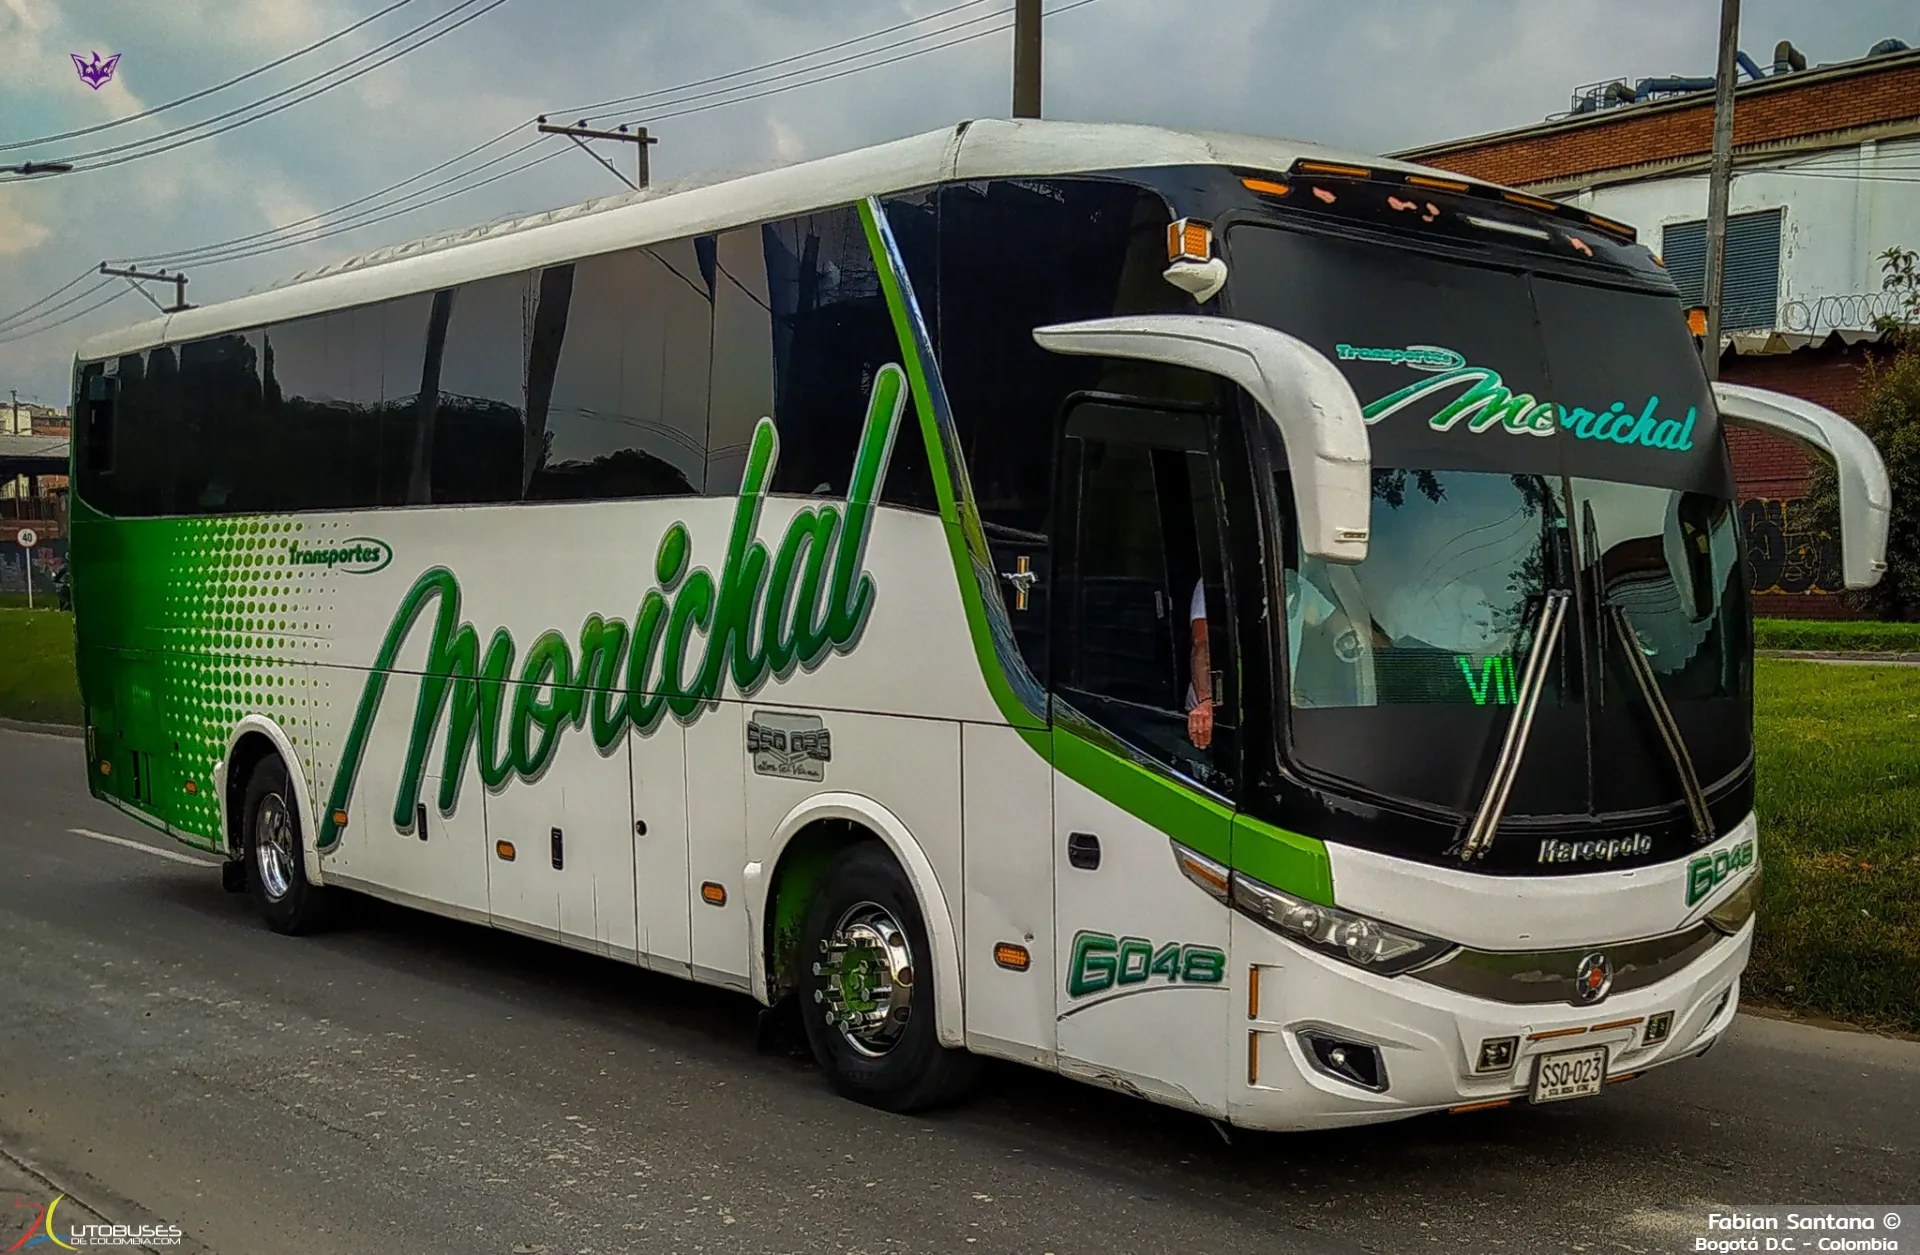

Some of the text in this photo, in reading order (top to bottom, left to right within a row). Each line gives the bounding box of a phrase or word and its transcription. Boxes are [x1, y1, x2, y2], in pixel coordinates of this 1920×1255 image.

[1335, 344, 1453, 365] Transportes
[1361, 366, 1697, 451] Morichal
[22, 532, 33, 542] 40
[288, 543, 381, 569] Transportes
[316, 362, 907, 854] Morichal
[1537, 832, 1652, 864] Marcopolo
[1066, 930, 1227, 1000] 6048
